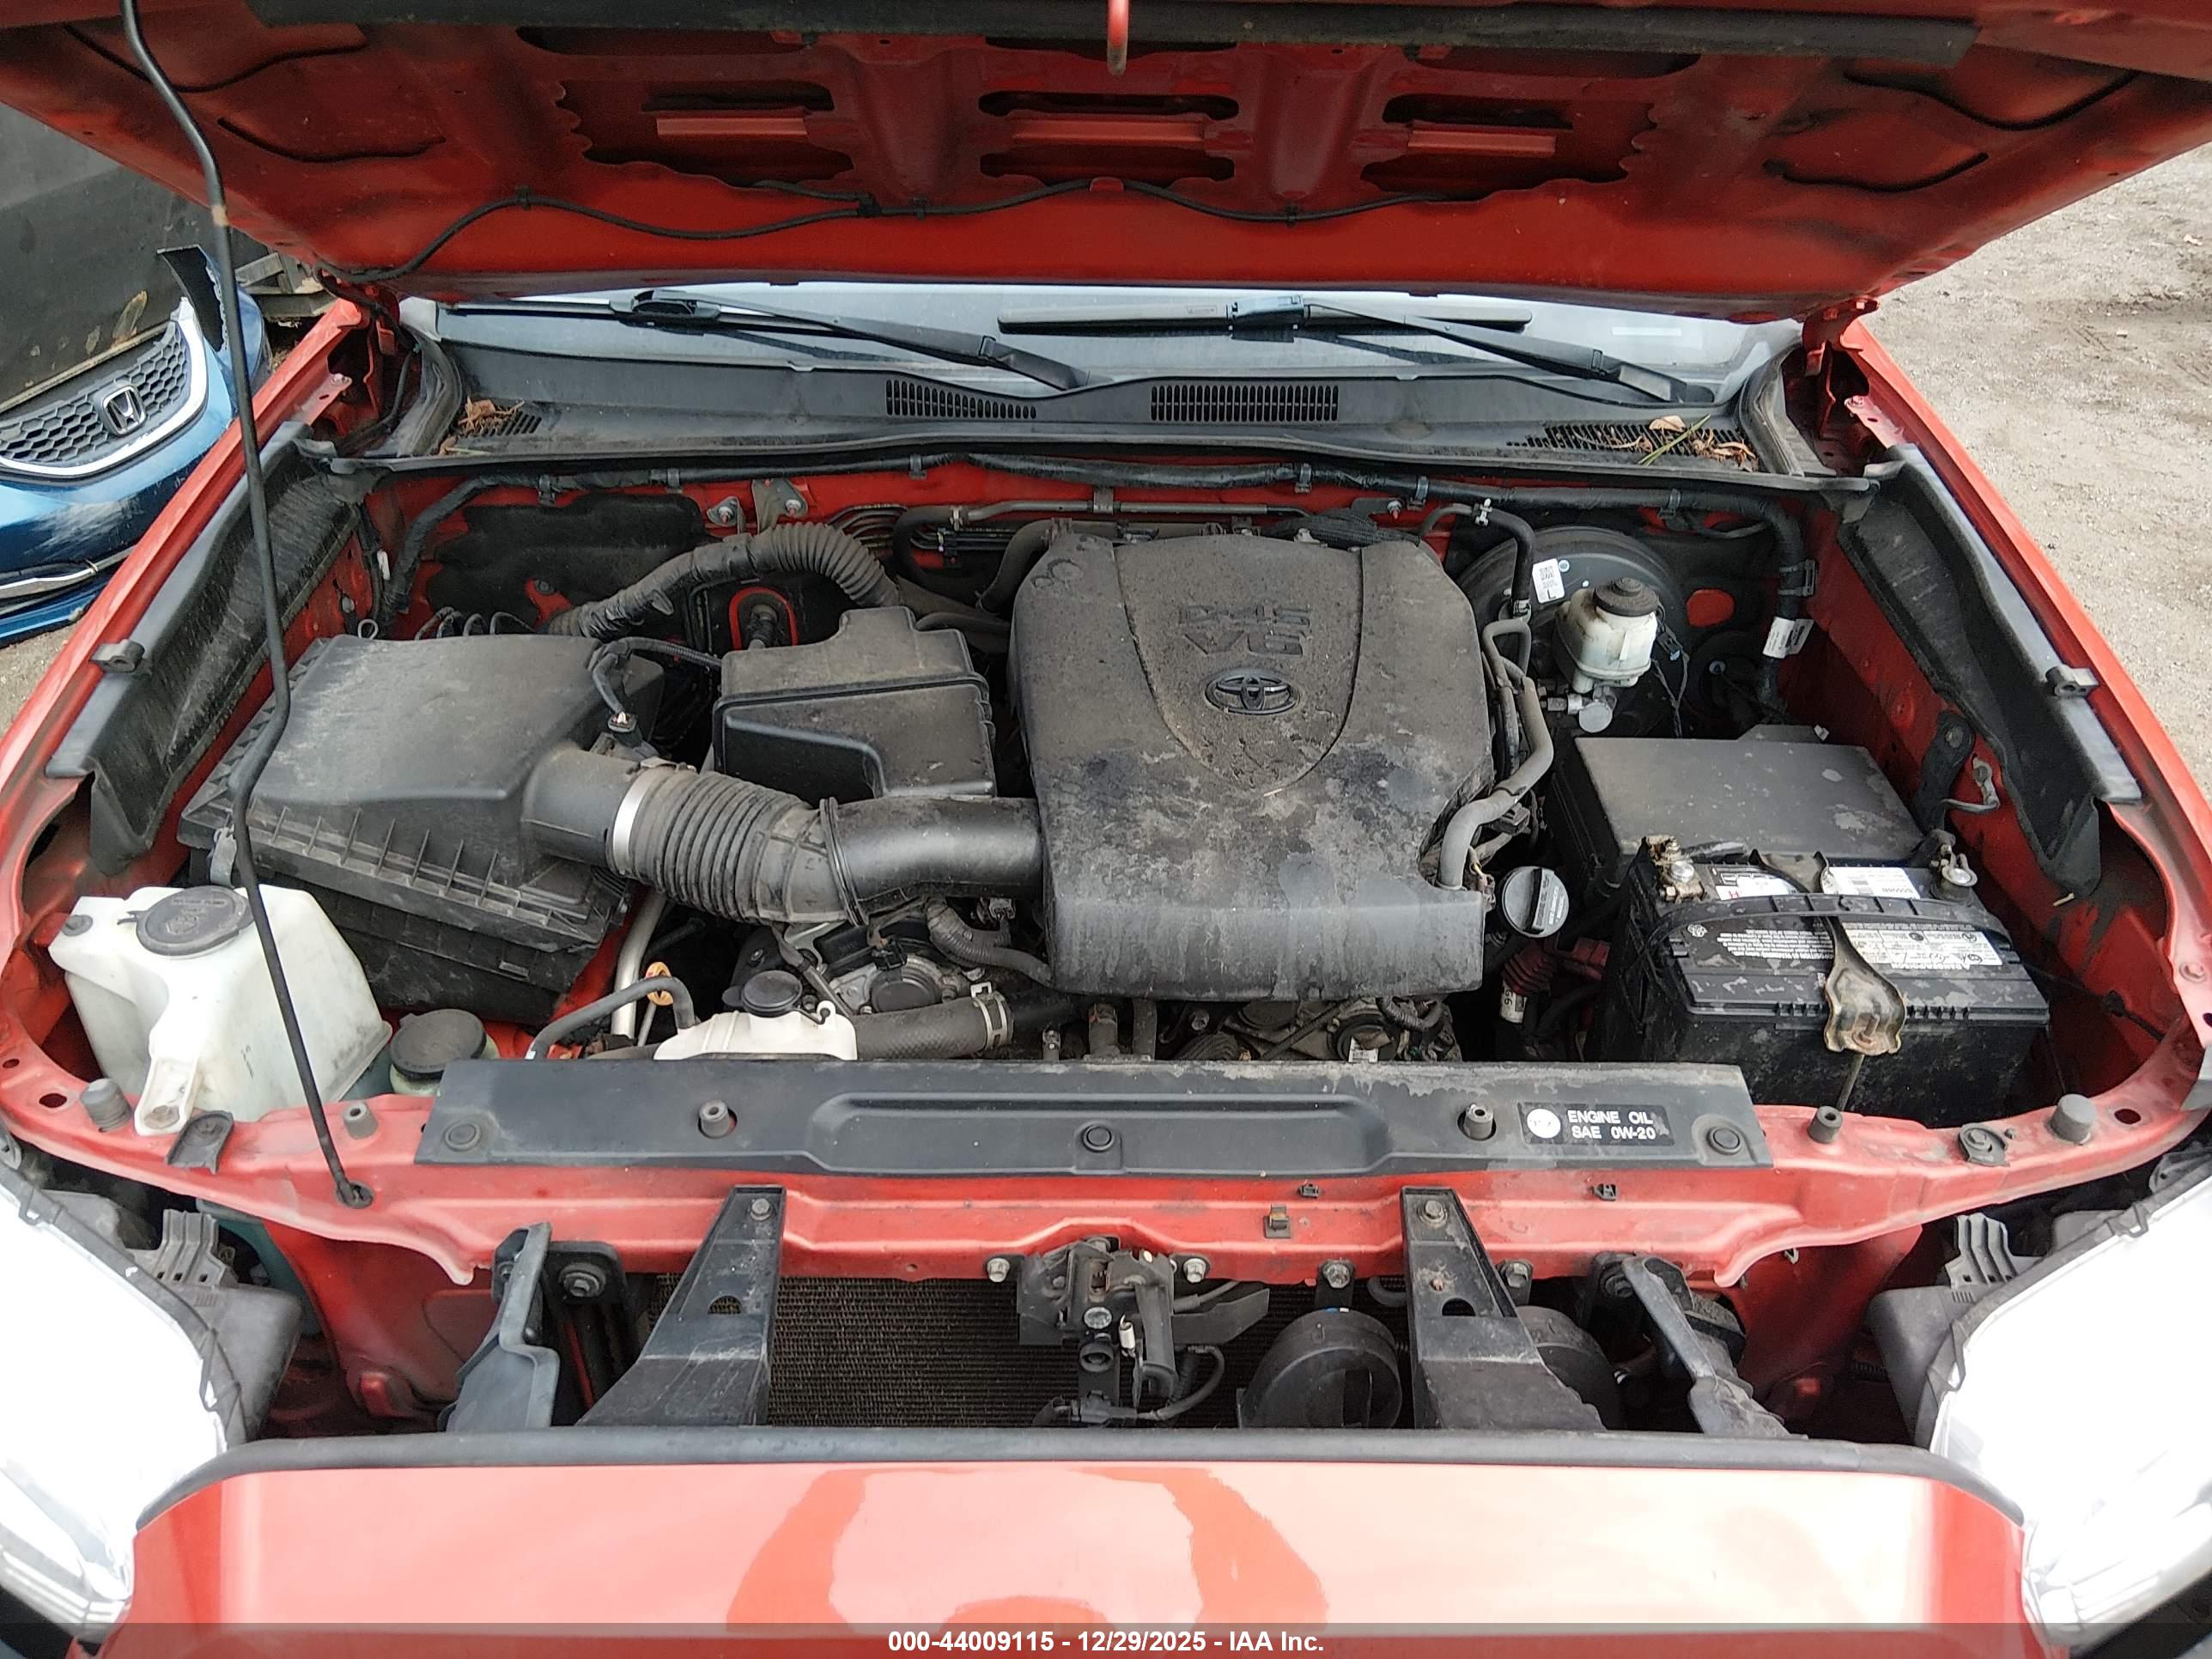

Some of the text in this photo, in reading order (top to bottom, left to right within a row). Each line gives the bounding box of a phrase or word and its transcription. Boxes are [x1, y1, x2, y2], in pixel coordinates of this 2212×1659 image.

[1567, 1109, 1654, 1125] ENGINE OIL
[1571, 1125, 1656, 1140] SAE 0W-20
